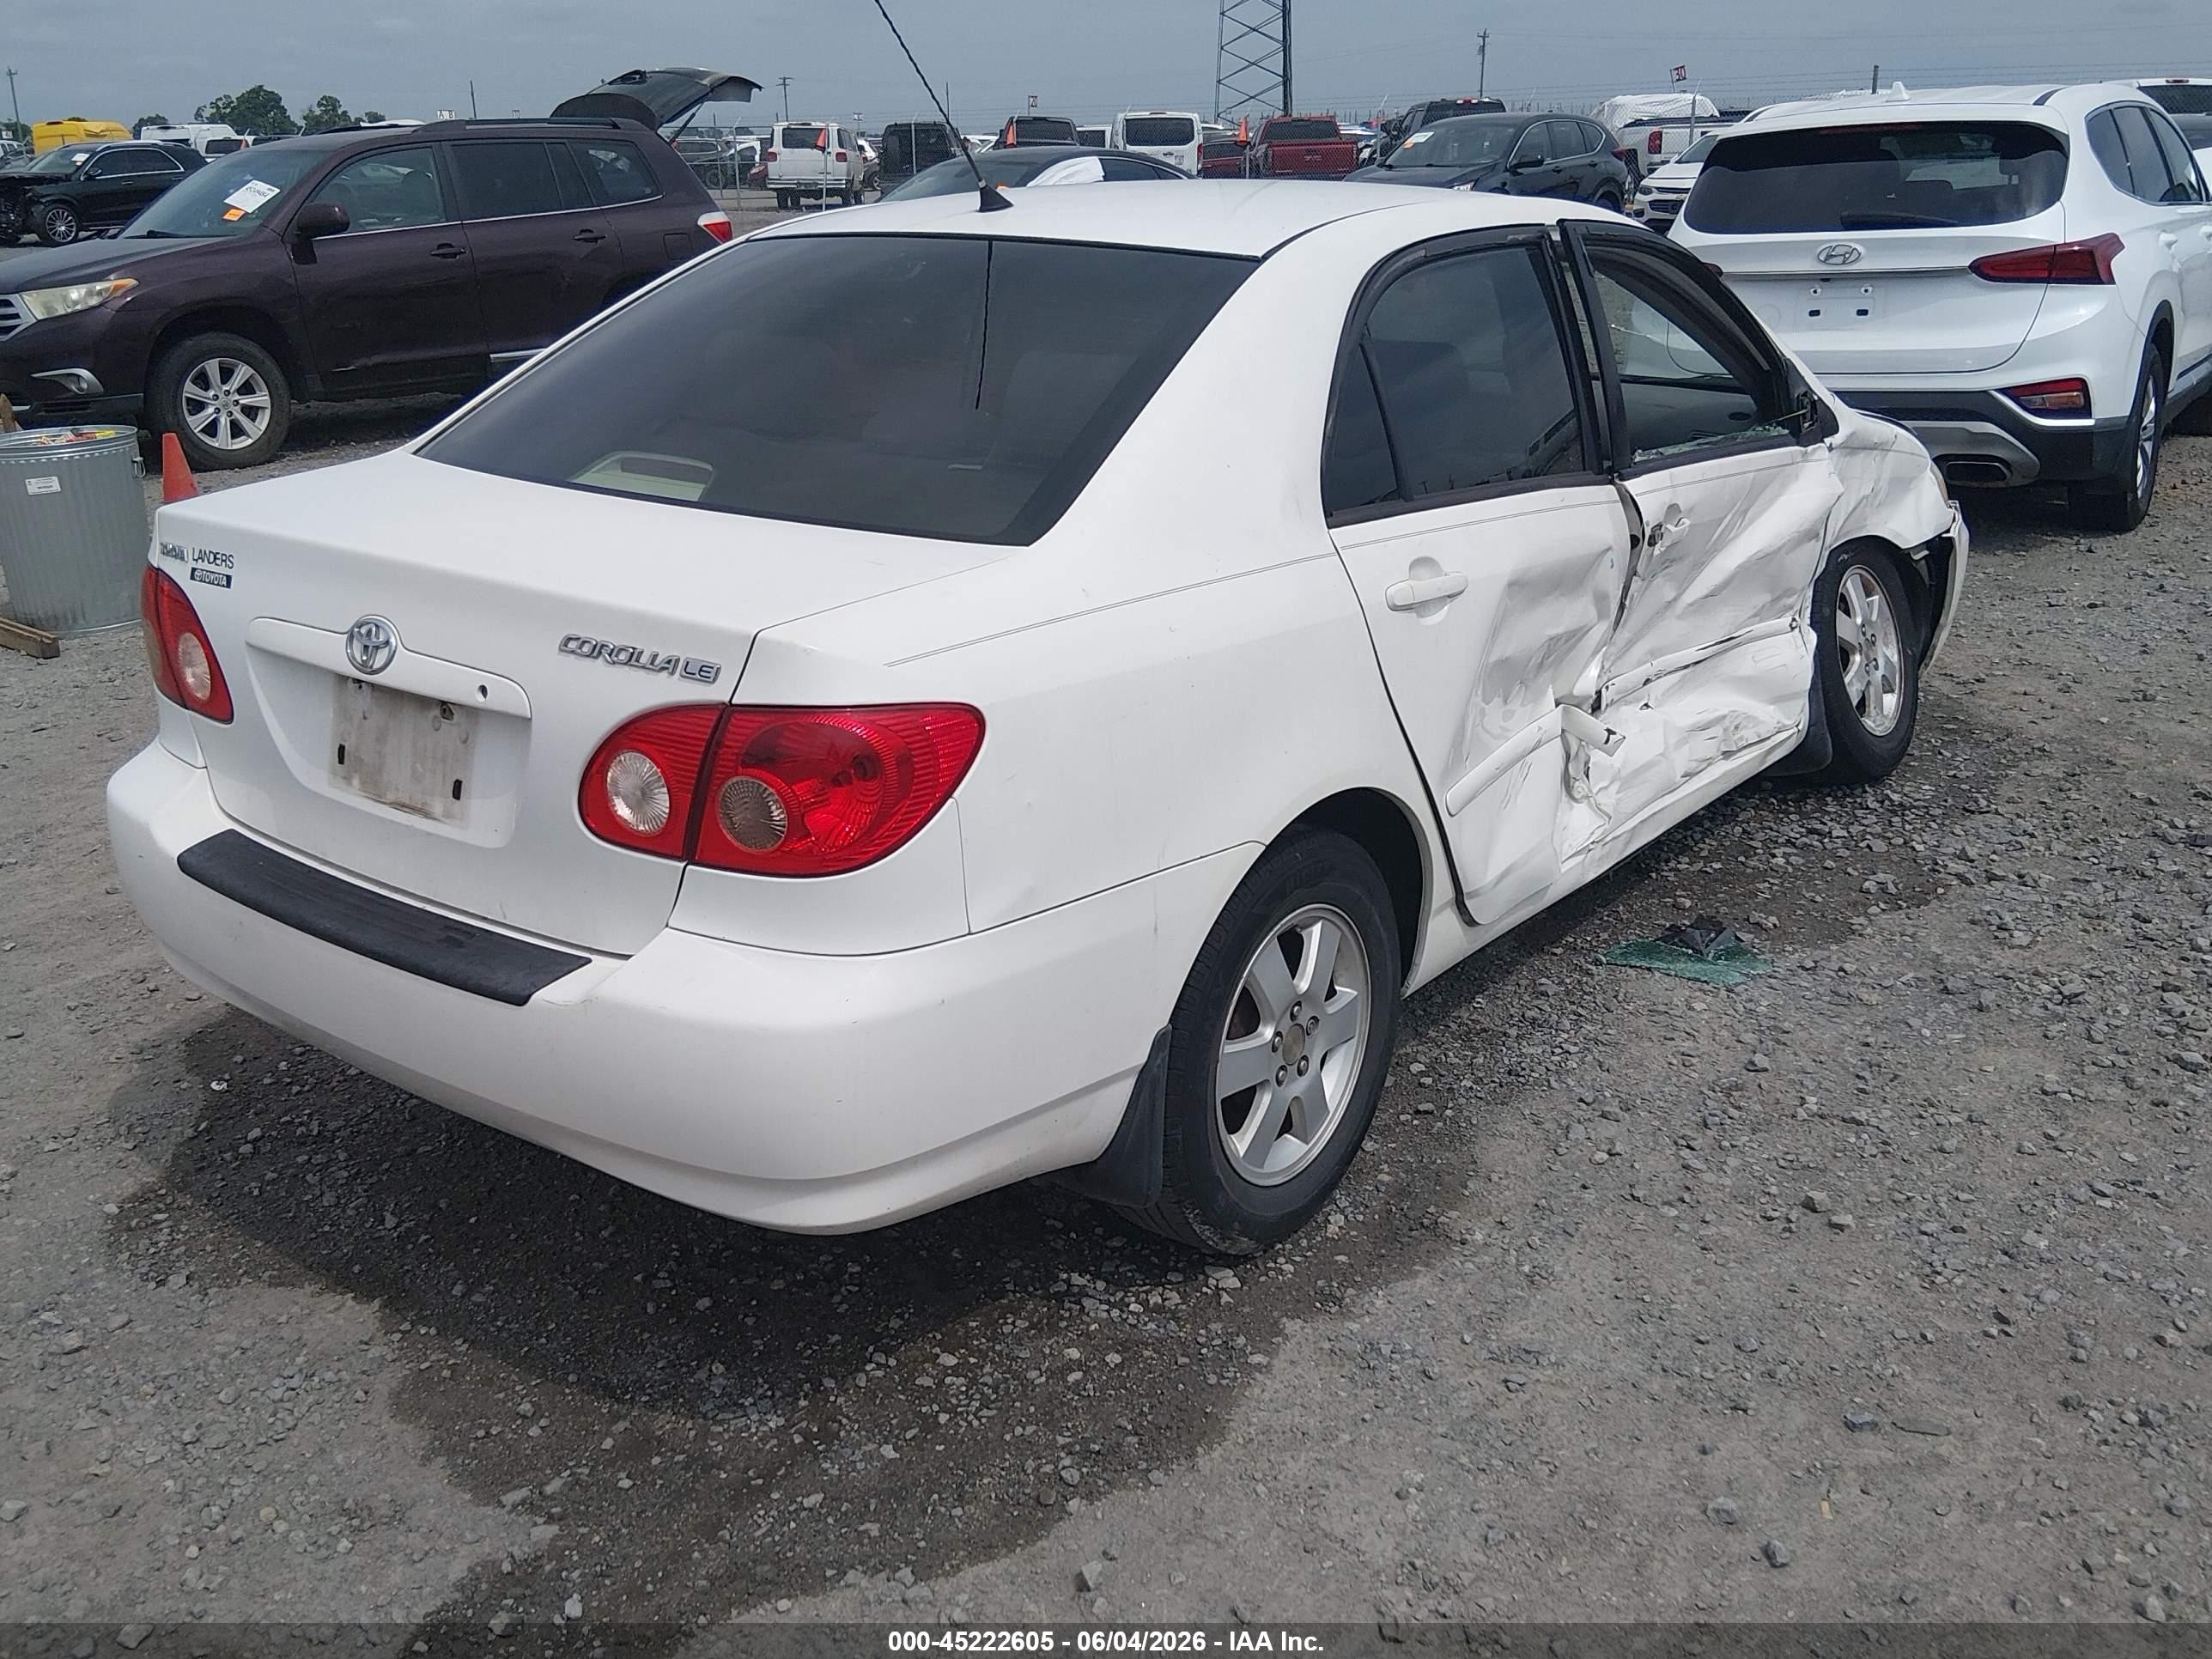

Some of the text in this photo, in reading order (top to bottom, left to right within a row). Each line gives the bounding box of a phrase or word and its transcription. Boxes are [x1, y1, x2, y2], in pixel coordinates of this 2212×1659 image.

[191, 547, 234, 569] LANDERS
[202, 569, 228, 587] TOYOTA
[558, 634, 717, 680] COROLLA LE
